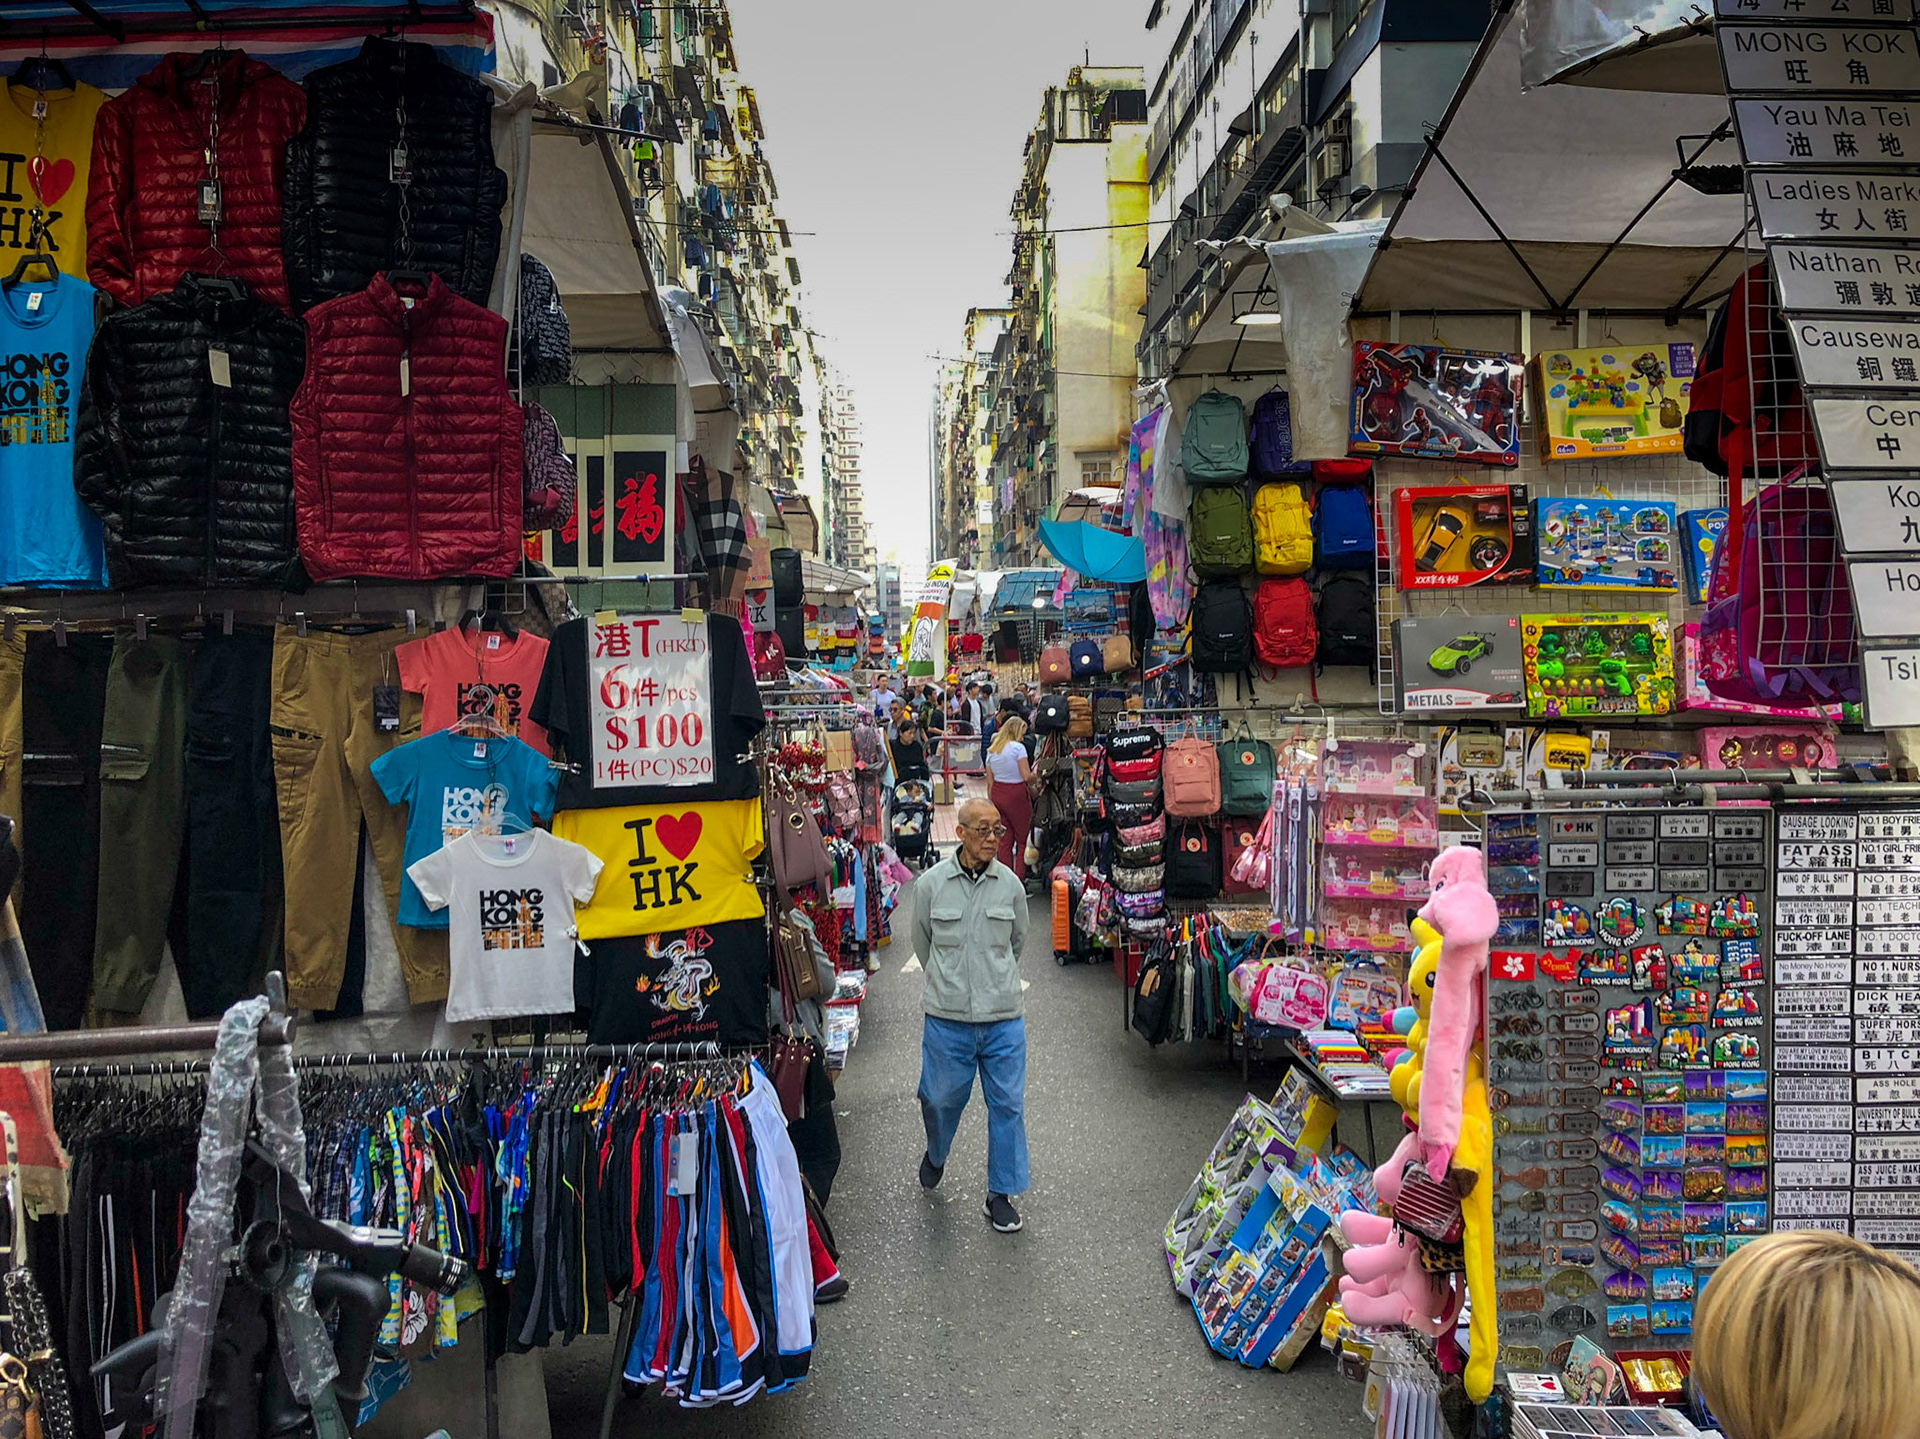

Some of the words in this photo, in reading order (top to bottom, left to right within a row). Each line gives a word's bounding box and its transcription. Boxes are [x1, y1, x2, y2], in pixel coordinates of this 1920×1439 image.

[1734, 32, 1827, 53] MONG
[1842, 33, 1905, 54] KOK
[1784, 59, 1870, 85] 旺角
[1763, 105, 1818, 126] Yau
[1824, 106, 1867, 126] Ma
[1870, 107, 1911, 127] Tei
[1786, 131, 1904, 158] 油麻地
[0, 153, 26, 202] I
[1765, 180, 1850, 200] Ladies
[1816, 207, 1908, 232] 女人街
[0, 206, 62, 251] HK
[1788, 250, 1881, 274] Nathan
[1801, 325, 1920, 349] Causewa
[1856, 356, 1919, 382] 銅鑼
[1876, 432, 1901, 460] 中
[1887, 485, 1920, 508] Ko
[616, 473, 664, 545] 福
[1543, 567, 1582, 583] TAYO
[1885, 568, 1920, 592] Ho
[1881, 656, 1918, 681] Tsi
[457, 683, 522, 700] HONG
[1409, 694, 1453, 707] METALS
[605, 712, 704, 753] $100
[1112, 734, 1151, 748] Supreme
[443, 802, 500, 823] KON
[1556, 823, 1561, 833] I
[1576, 822, 1594, 832] HK
[1783, 816, 1818, 828] SAUSAGE
[1820, 816, 1854, 829] LOOKING
[1860, 816, 1880, 825] NO.1
[1882, 816, 1902, 825] BOY
[1864, 826, 1920, 836] 最佳男
[624, 818, 657, 867] I
[1861, 844, 1880, 853] NO.1
[1882, 844, 1902, 853] GIRL
[1783, 845, 1813, 856] FAT
[1818, 845, 1853, 856] ASS
[1782, 874, 1798, 883] KING
[1801, 874, 1810, 883] OF
[1813, 874, 1830, 883] BULL
[1833, 874, 1848, 883] SHIT
[1863, 875, 1895, 883] NO.1
[630, 862, 702, 911] HK
[479, 888, 544, 907] HONG
[1124, 890, 1162, 903] Supreme
[1861, 903, 1882, 912] NO.1
[1887, 902, 1920, 911] TEACH
[480, 907, 544, 926] KONG
[1128, 918, 1166, 929] Supreme
[1864, 912, 1920, 922] 最佳老
[1599, 929, 1622, 947] HONG
[1623, 927, 1643, 947] KONG
[1777, 931, 1823, 942] FUCK-OFF
[1825, 931, 1850, 940] LANE
[1860, 933, 1883, 941] NO.1
[1779, 962, 1789, 970] No
[1790, 962, 1813, 970] Money
[1825, 962, 1847, 970] Honey
[1862, 962, 1877, 971] NO
[1591, 977, 1610, 985] HONG
[1612, 977, 1630, 985] KONG
[1857, 992, 1889, 1001] DICK
[1723, 1017, 1743, 1027] HONG
[1744, 1016, 1764, 1026] KONG
[1860, 1020, 1891, 1029] SUPER
[1857, 1108, 1892, 1119] UNIVERSITY
[1892, 1108, 1900, 1119] OF
[1902, 1108, 1917, 1119] BULL
[1859, 1139, 1884, 1147] PRIVATE
[1858, 1165, 1872, 1175] ASS
[1903, 1164, 1920, 1173] MAK
[1776, 1221, 1790, 1230] ASS
